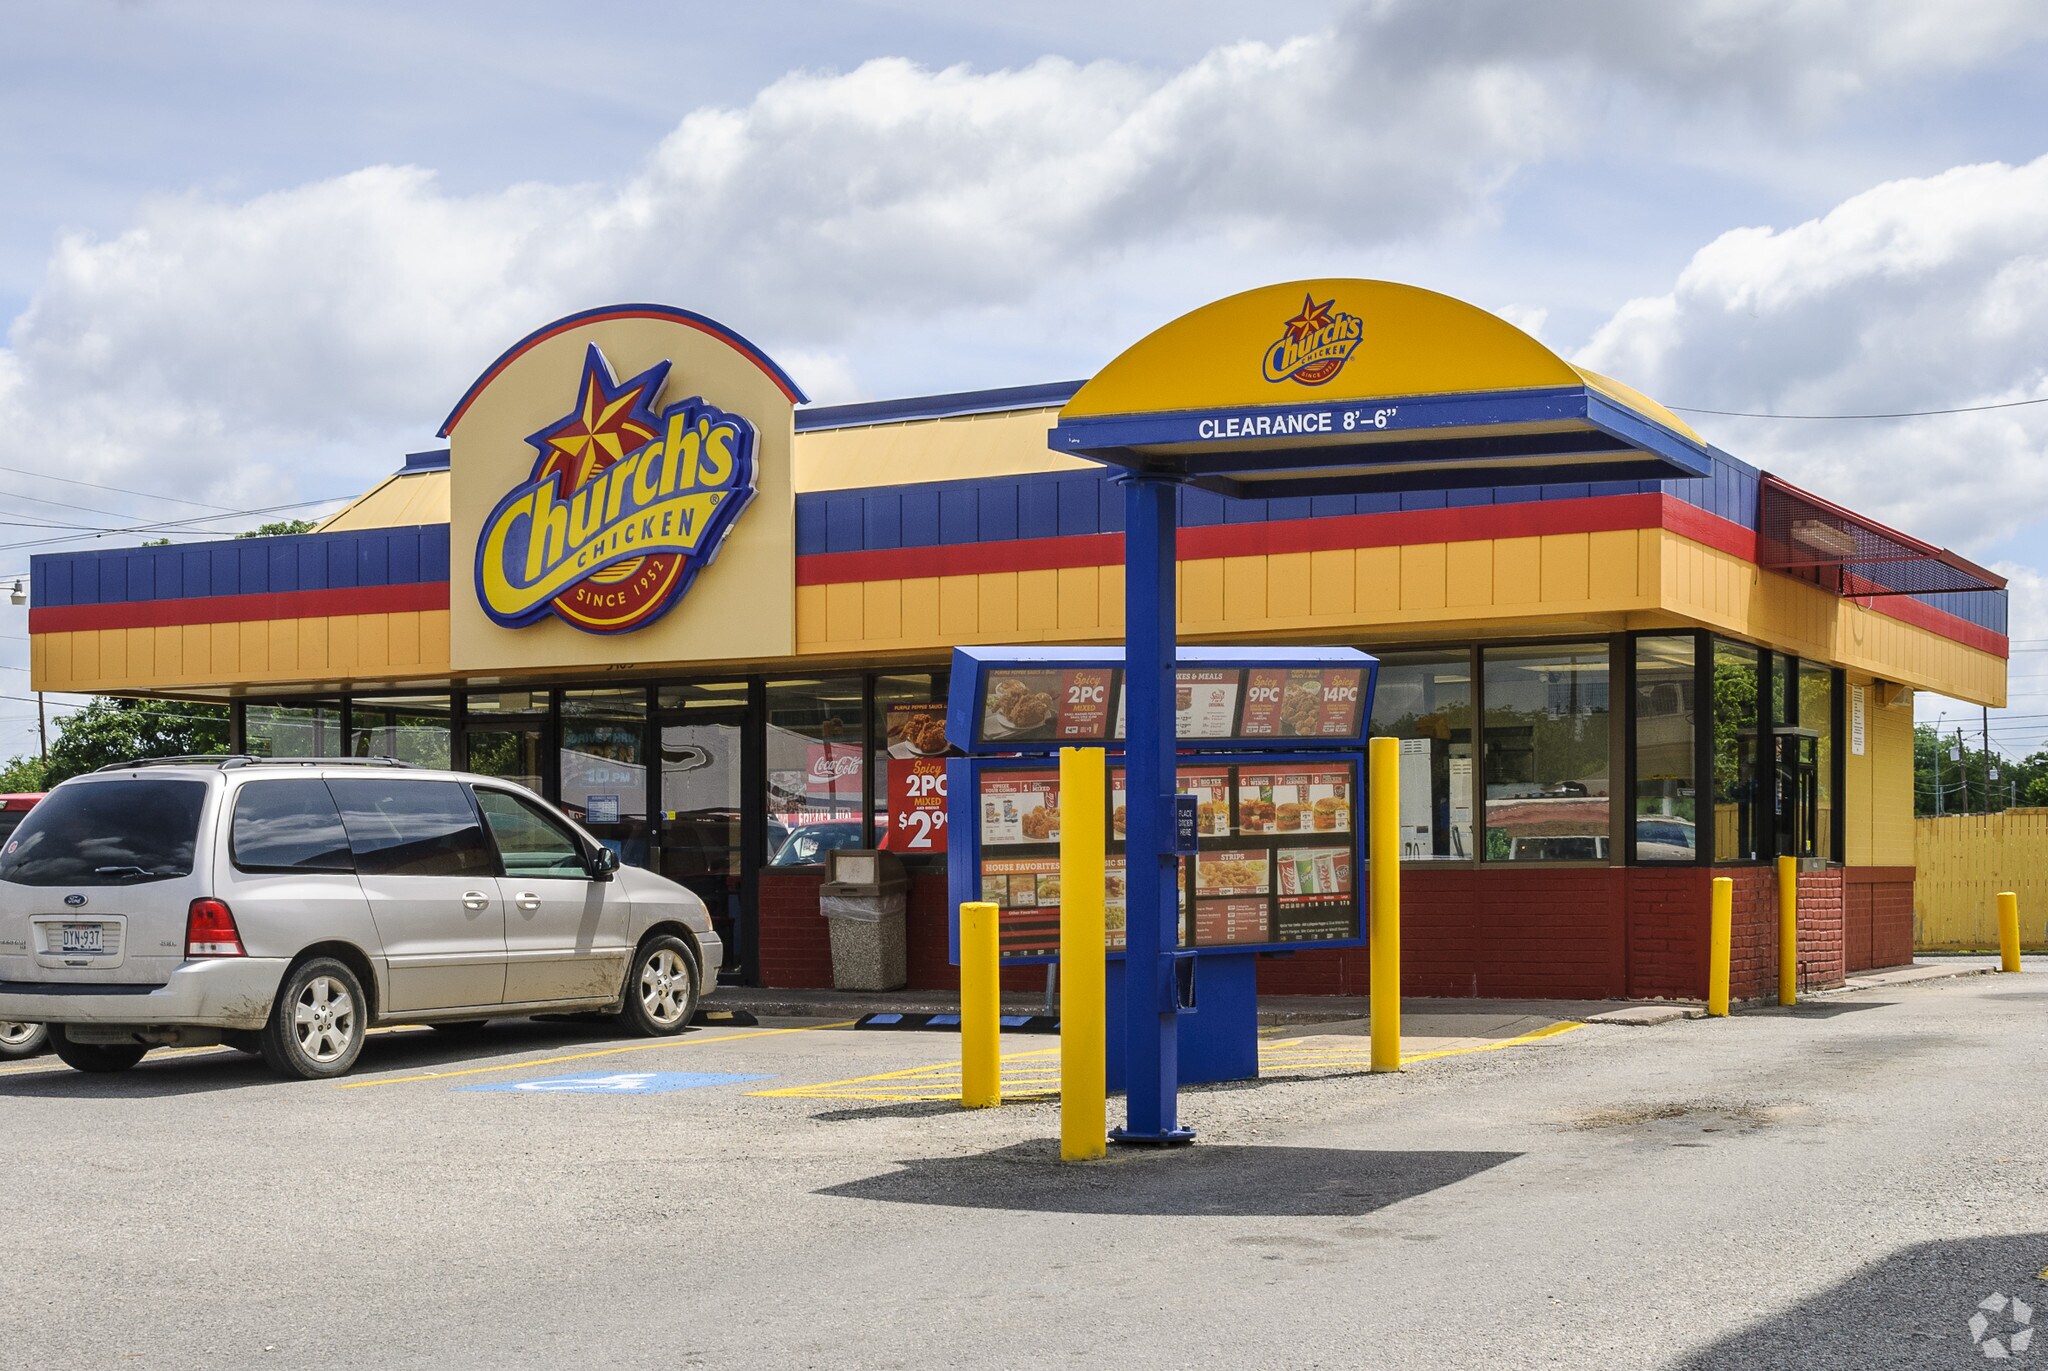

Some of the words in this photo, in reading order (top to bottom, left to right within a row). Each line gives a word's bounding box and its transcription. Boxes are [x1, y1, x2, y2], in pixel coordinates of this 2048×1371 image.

[1265, 314, 1359, 380] Church's
[1301, 345, 1346, 365] CHICKEN
[1199, 412, 1332, 439] CLEARANCE
[482, 412, 734, 614] Church's
[577, 508, 695, 568] CHICKEN
[576, 588, 627, 607] SINCE
[633, 560, 664, 596] 1952
[1073, 672, 1101, 687] Spicy
[1254, 675, 1278, 687] Spicy
[1332, 675, 1355, 688] Spicy
[1067, 686, 1104, 703] 2PC
[1249, 687, 1280, 702] 9PC
[1323, 687, 1358, 702] 14PC
[1073, 704, 1096, 712] MIXED
[587, 768, 609, 783] 10
[612, 771, 630, 782] PM
[913, 760, 942, 776] Spicy
[906, 774, 947, 797] 2PC
[1115, 782, 1120, 790] 3
[1314, 776, 1320, 784] 8
[1023, 784, 1028, 792] 1
[914, 797, 941, 806] MIXED
[1178, 809, 1193, 817] PLACE
[1180, 828, 1192, 836] HERE
[986, 862, 1014, 871] HOUSE
[1015, 862, 1060, 870] FAVORITES
